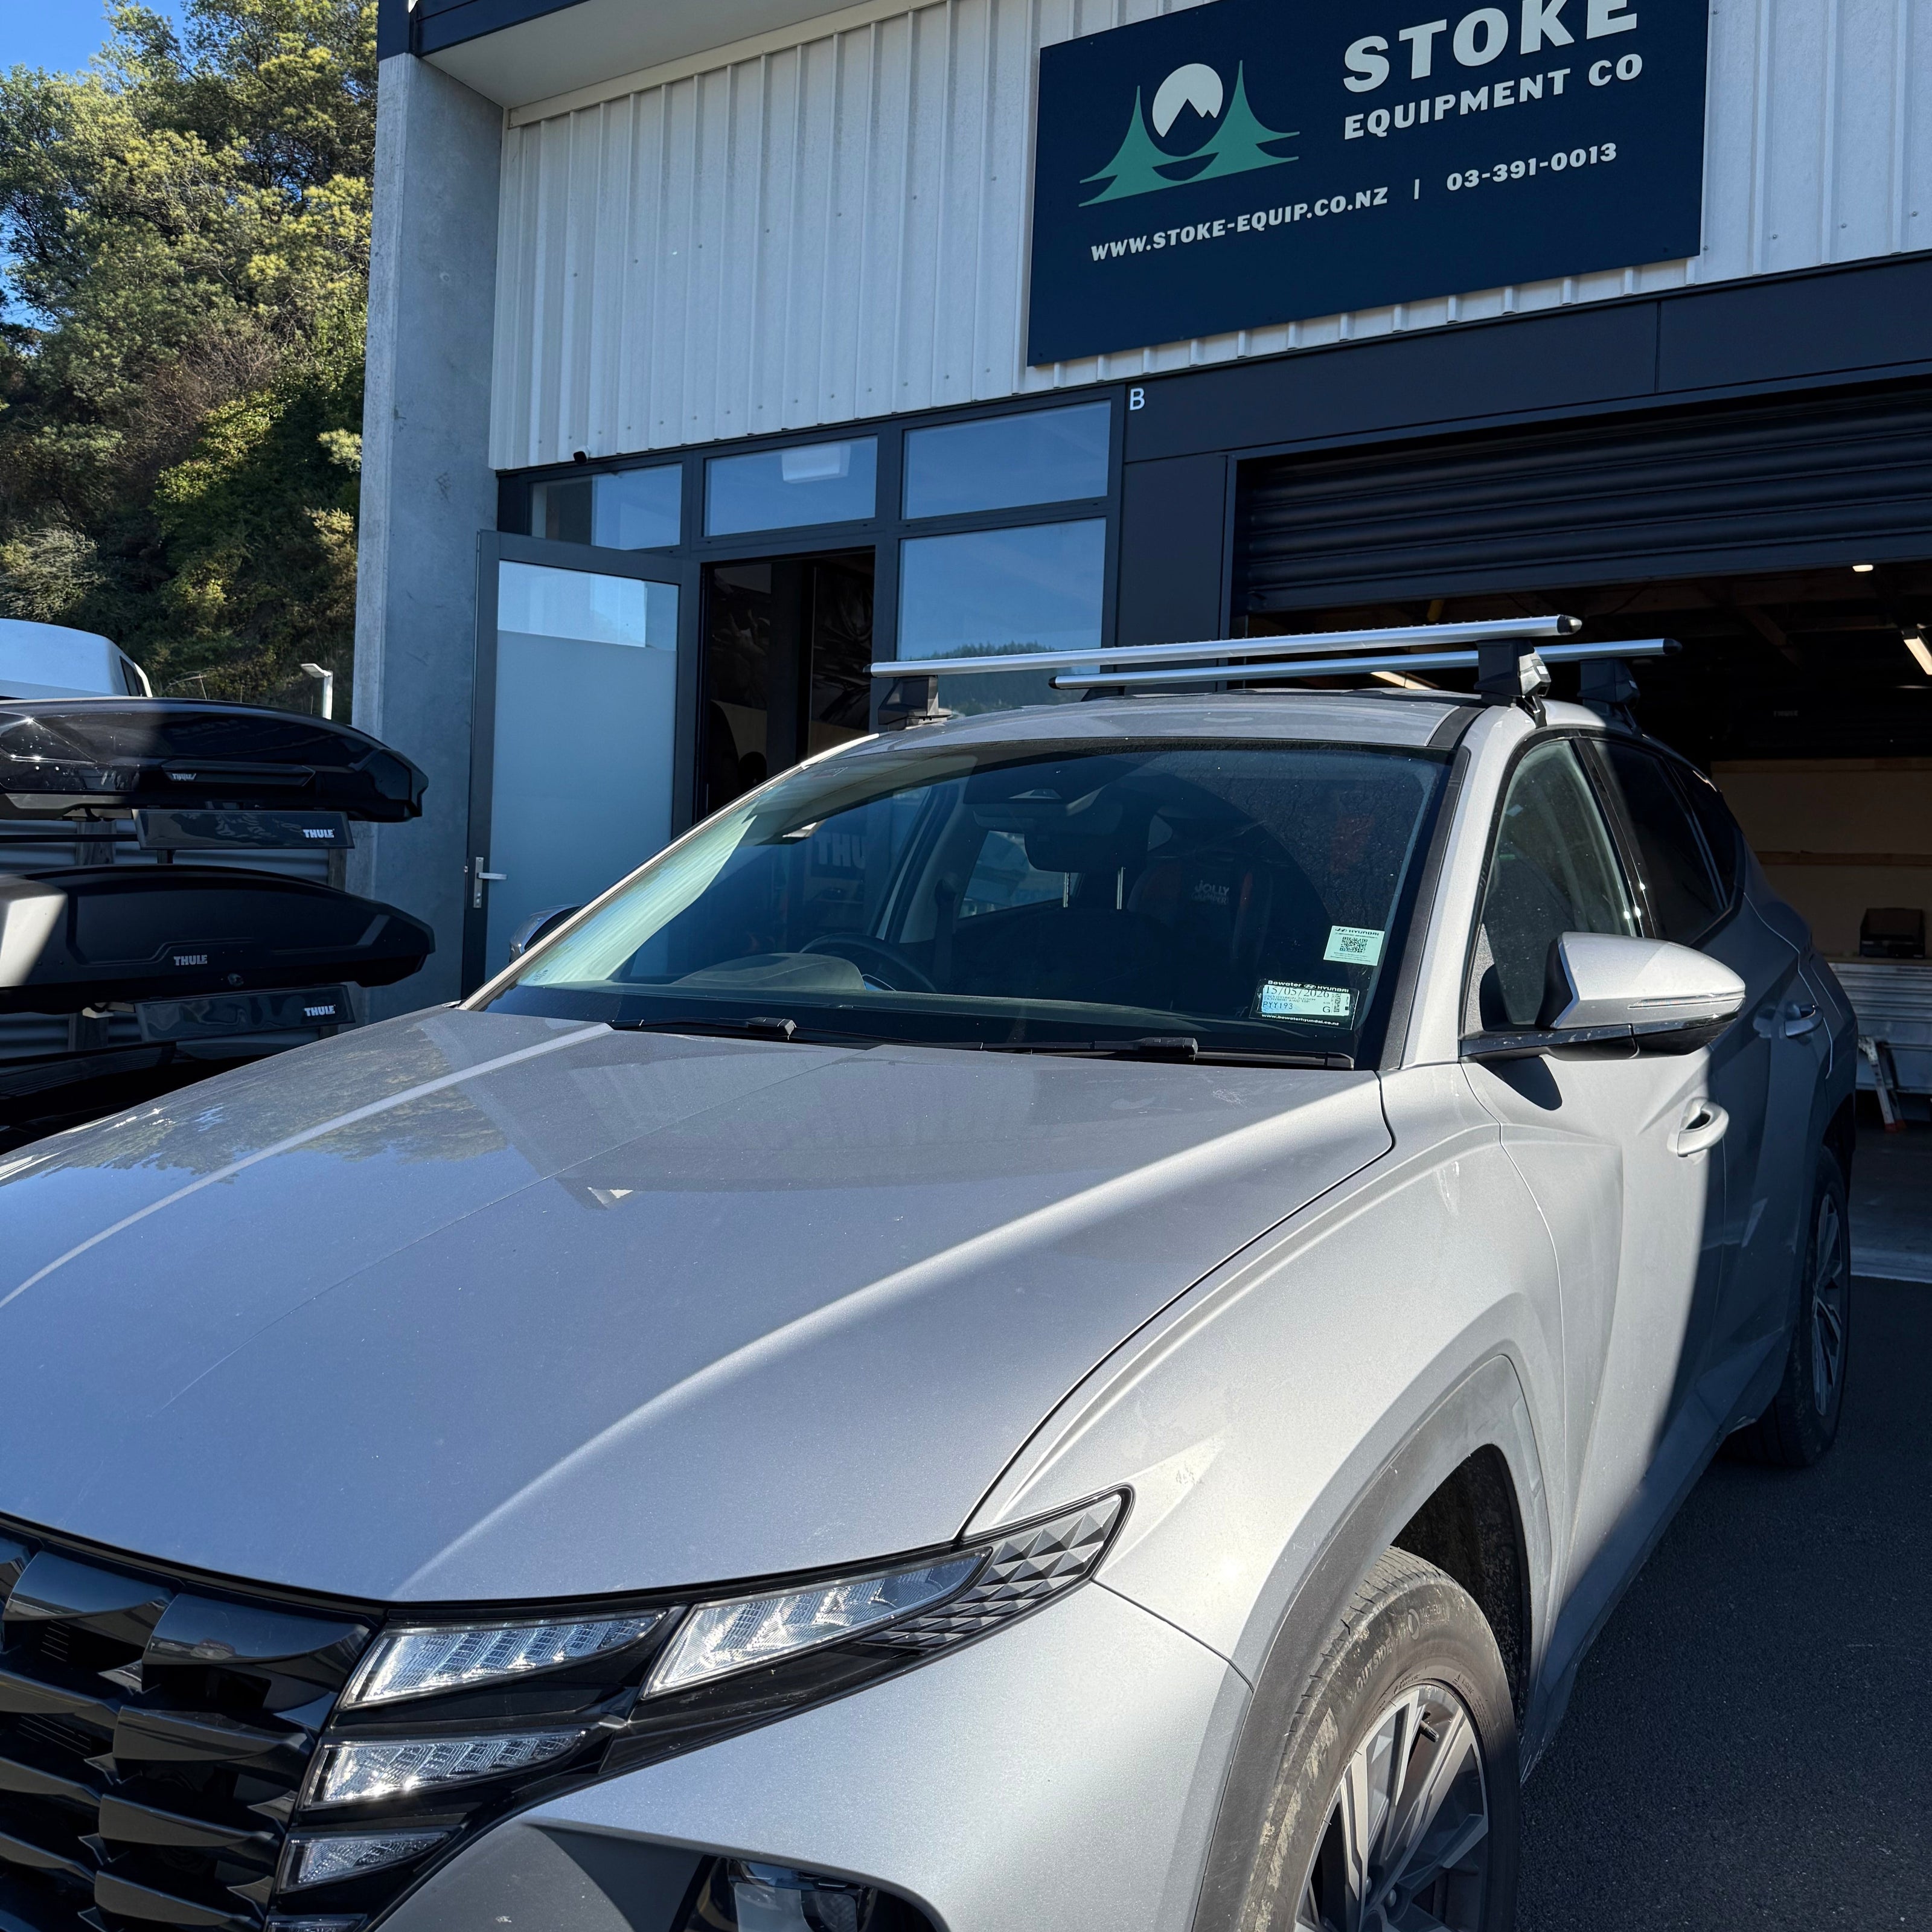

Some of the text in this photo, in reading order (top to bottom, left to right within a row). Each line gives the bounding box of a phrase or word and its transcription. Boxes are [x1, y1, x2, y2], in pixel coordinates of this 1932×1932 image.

[1343, 0, 1637, 92] STOKE
[1345, 54, 1642, 139] EQUIPMENT CO
[1091, 187, 1388, 262] WWW.STOKE-EQUIP.CO.NZ
[1446, 142, 1617, 192] 03-391-0013
[1130, 388, 1145, 411] B
[302, 829, 334, 838] THULE
[173, 955, 208, 966] THULE
[304, 1005, 336, 1017] THULE
[1262, 1001, 1293, 1009] PYY193
[1356, 1637, 1392, 1693] OUTSIDE
